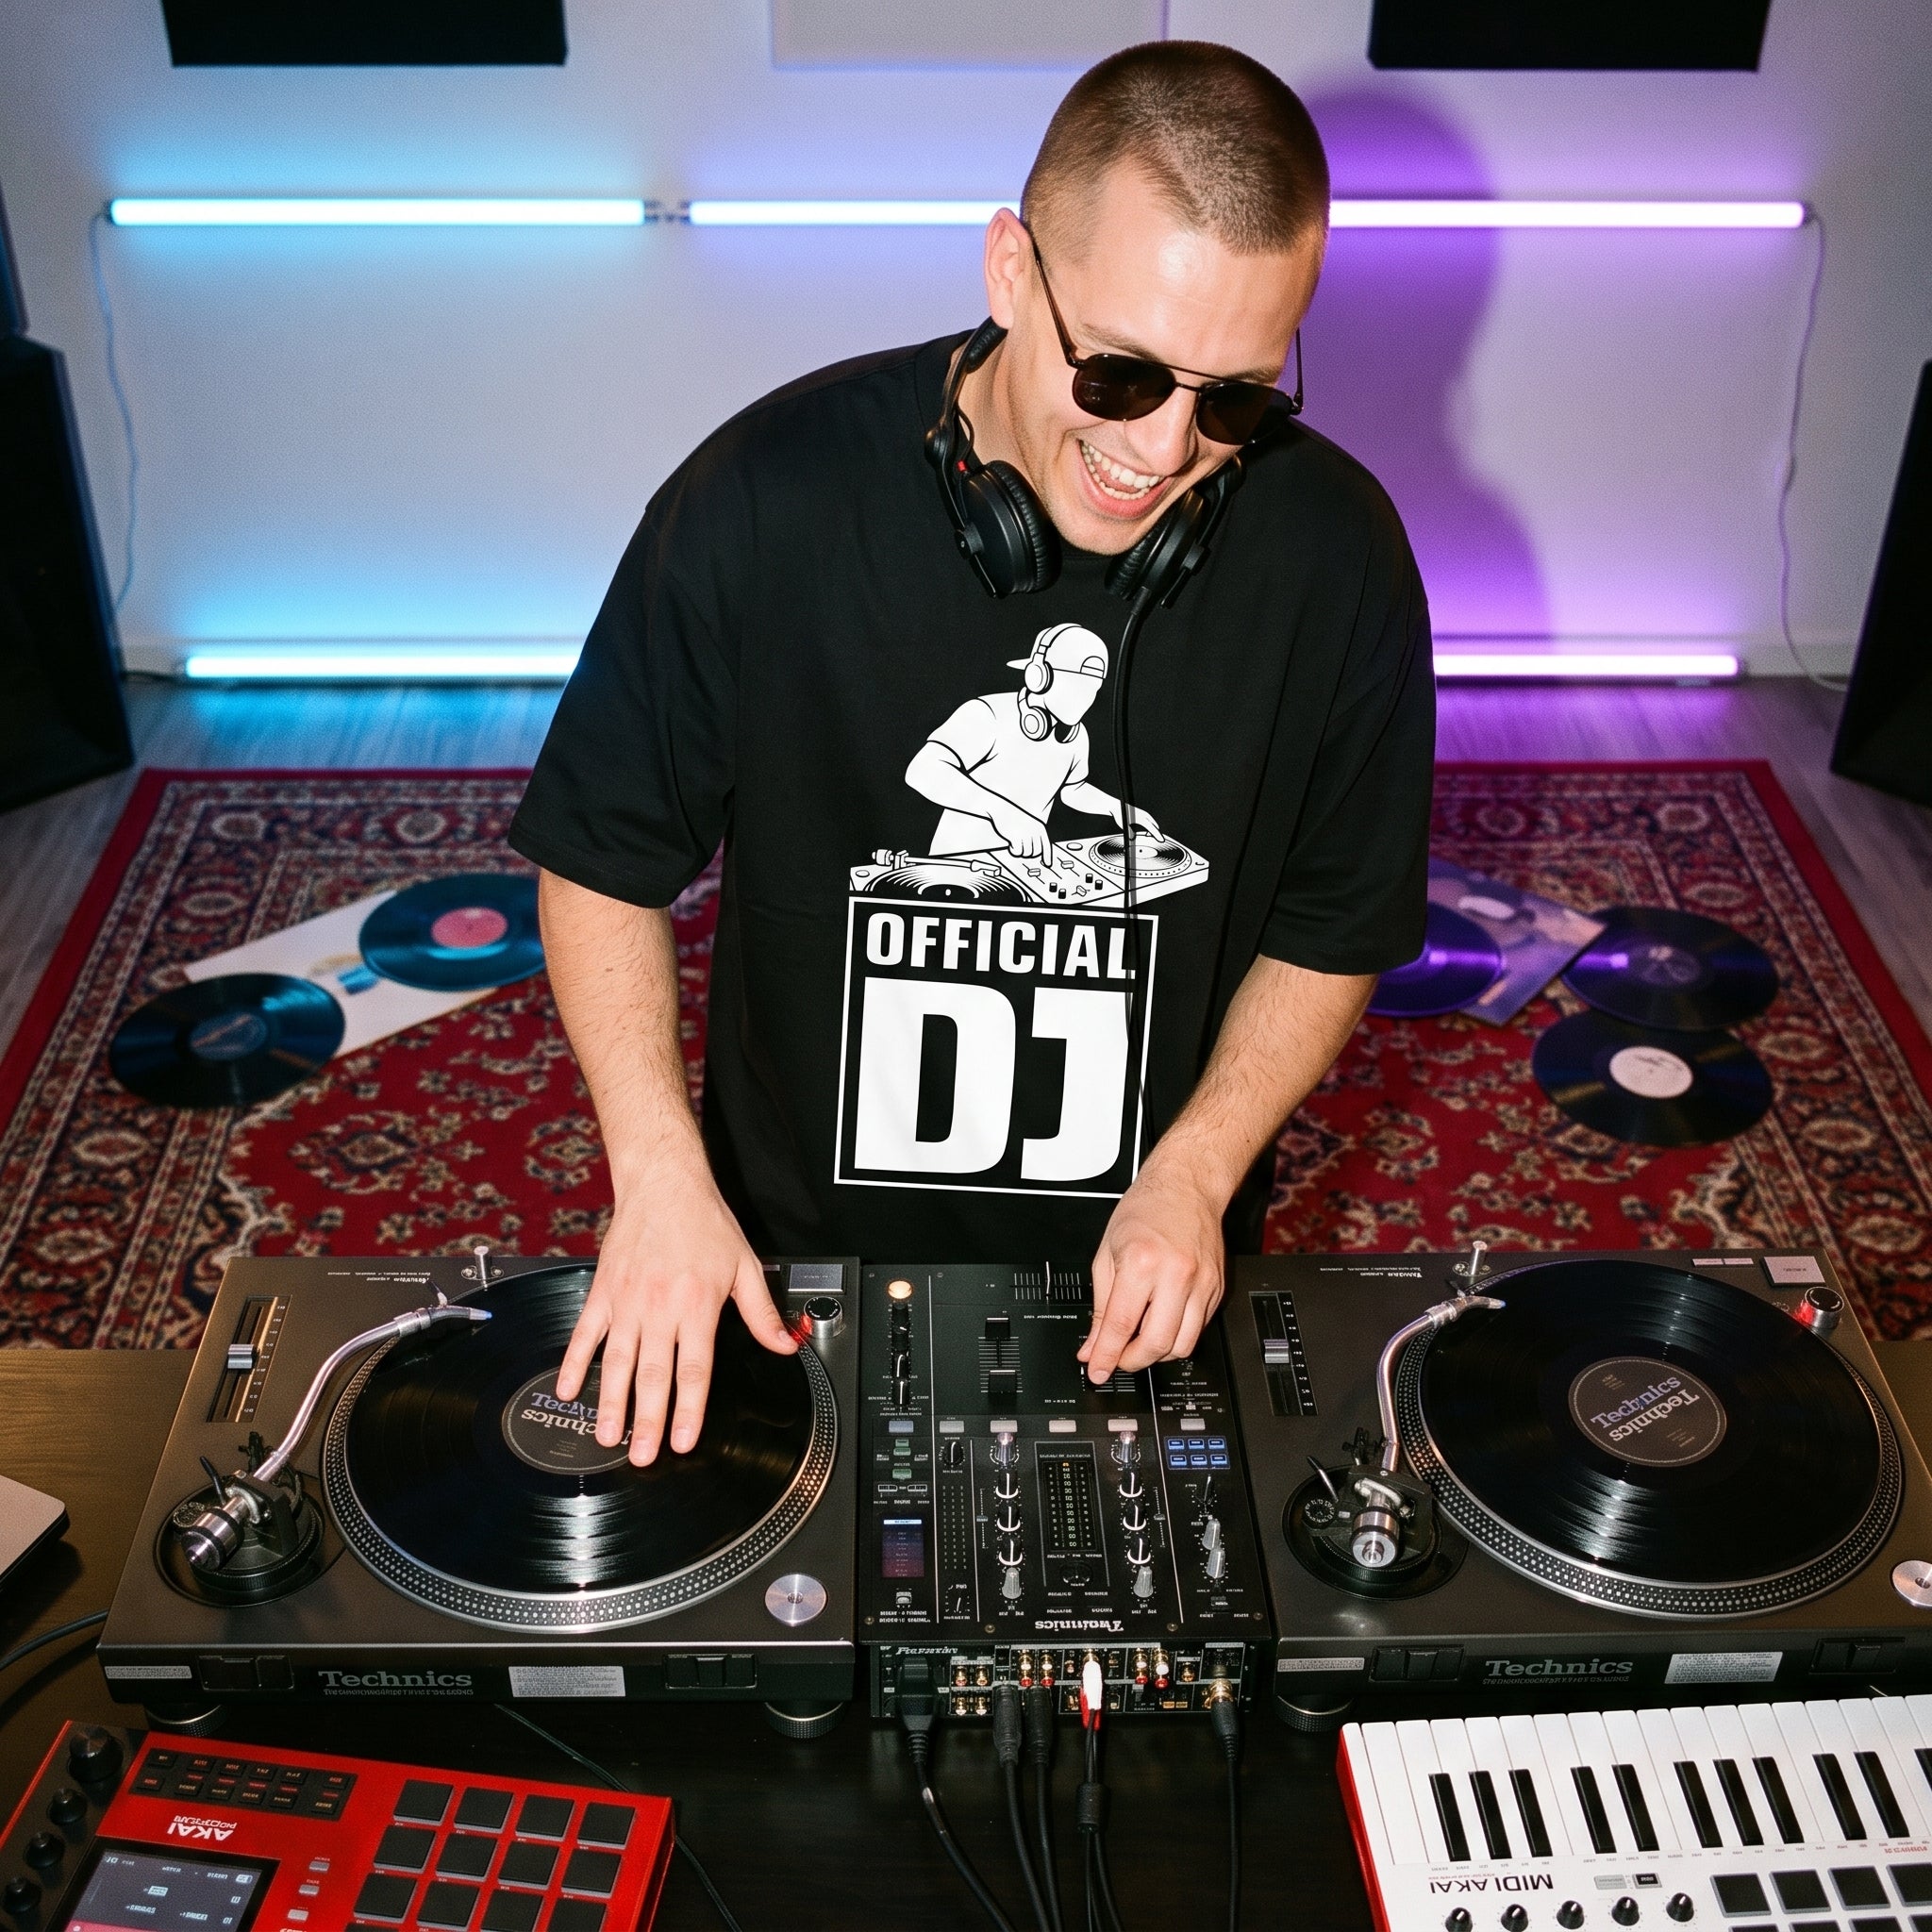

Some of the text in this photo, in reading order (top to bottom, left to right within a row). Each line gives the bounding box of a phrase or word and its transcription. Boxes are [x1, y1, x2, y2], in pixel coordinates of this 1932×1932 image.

[866, 912, 1136, 980] OFFICIAL
[854, 976, 1134, 1182] DJ
[1608, 1389, 1700, 1441] Technics
[1485, 1659, 1634, 1676] Technics
[318, 1671, 473, 1687] Technics
[167, 1822, 234, 1841] AKAI
[1429, 1874, 1554, 1894] MIDI AKAI
